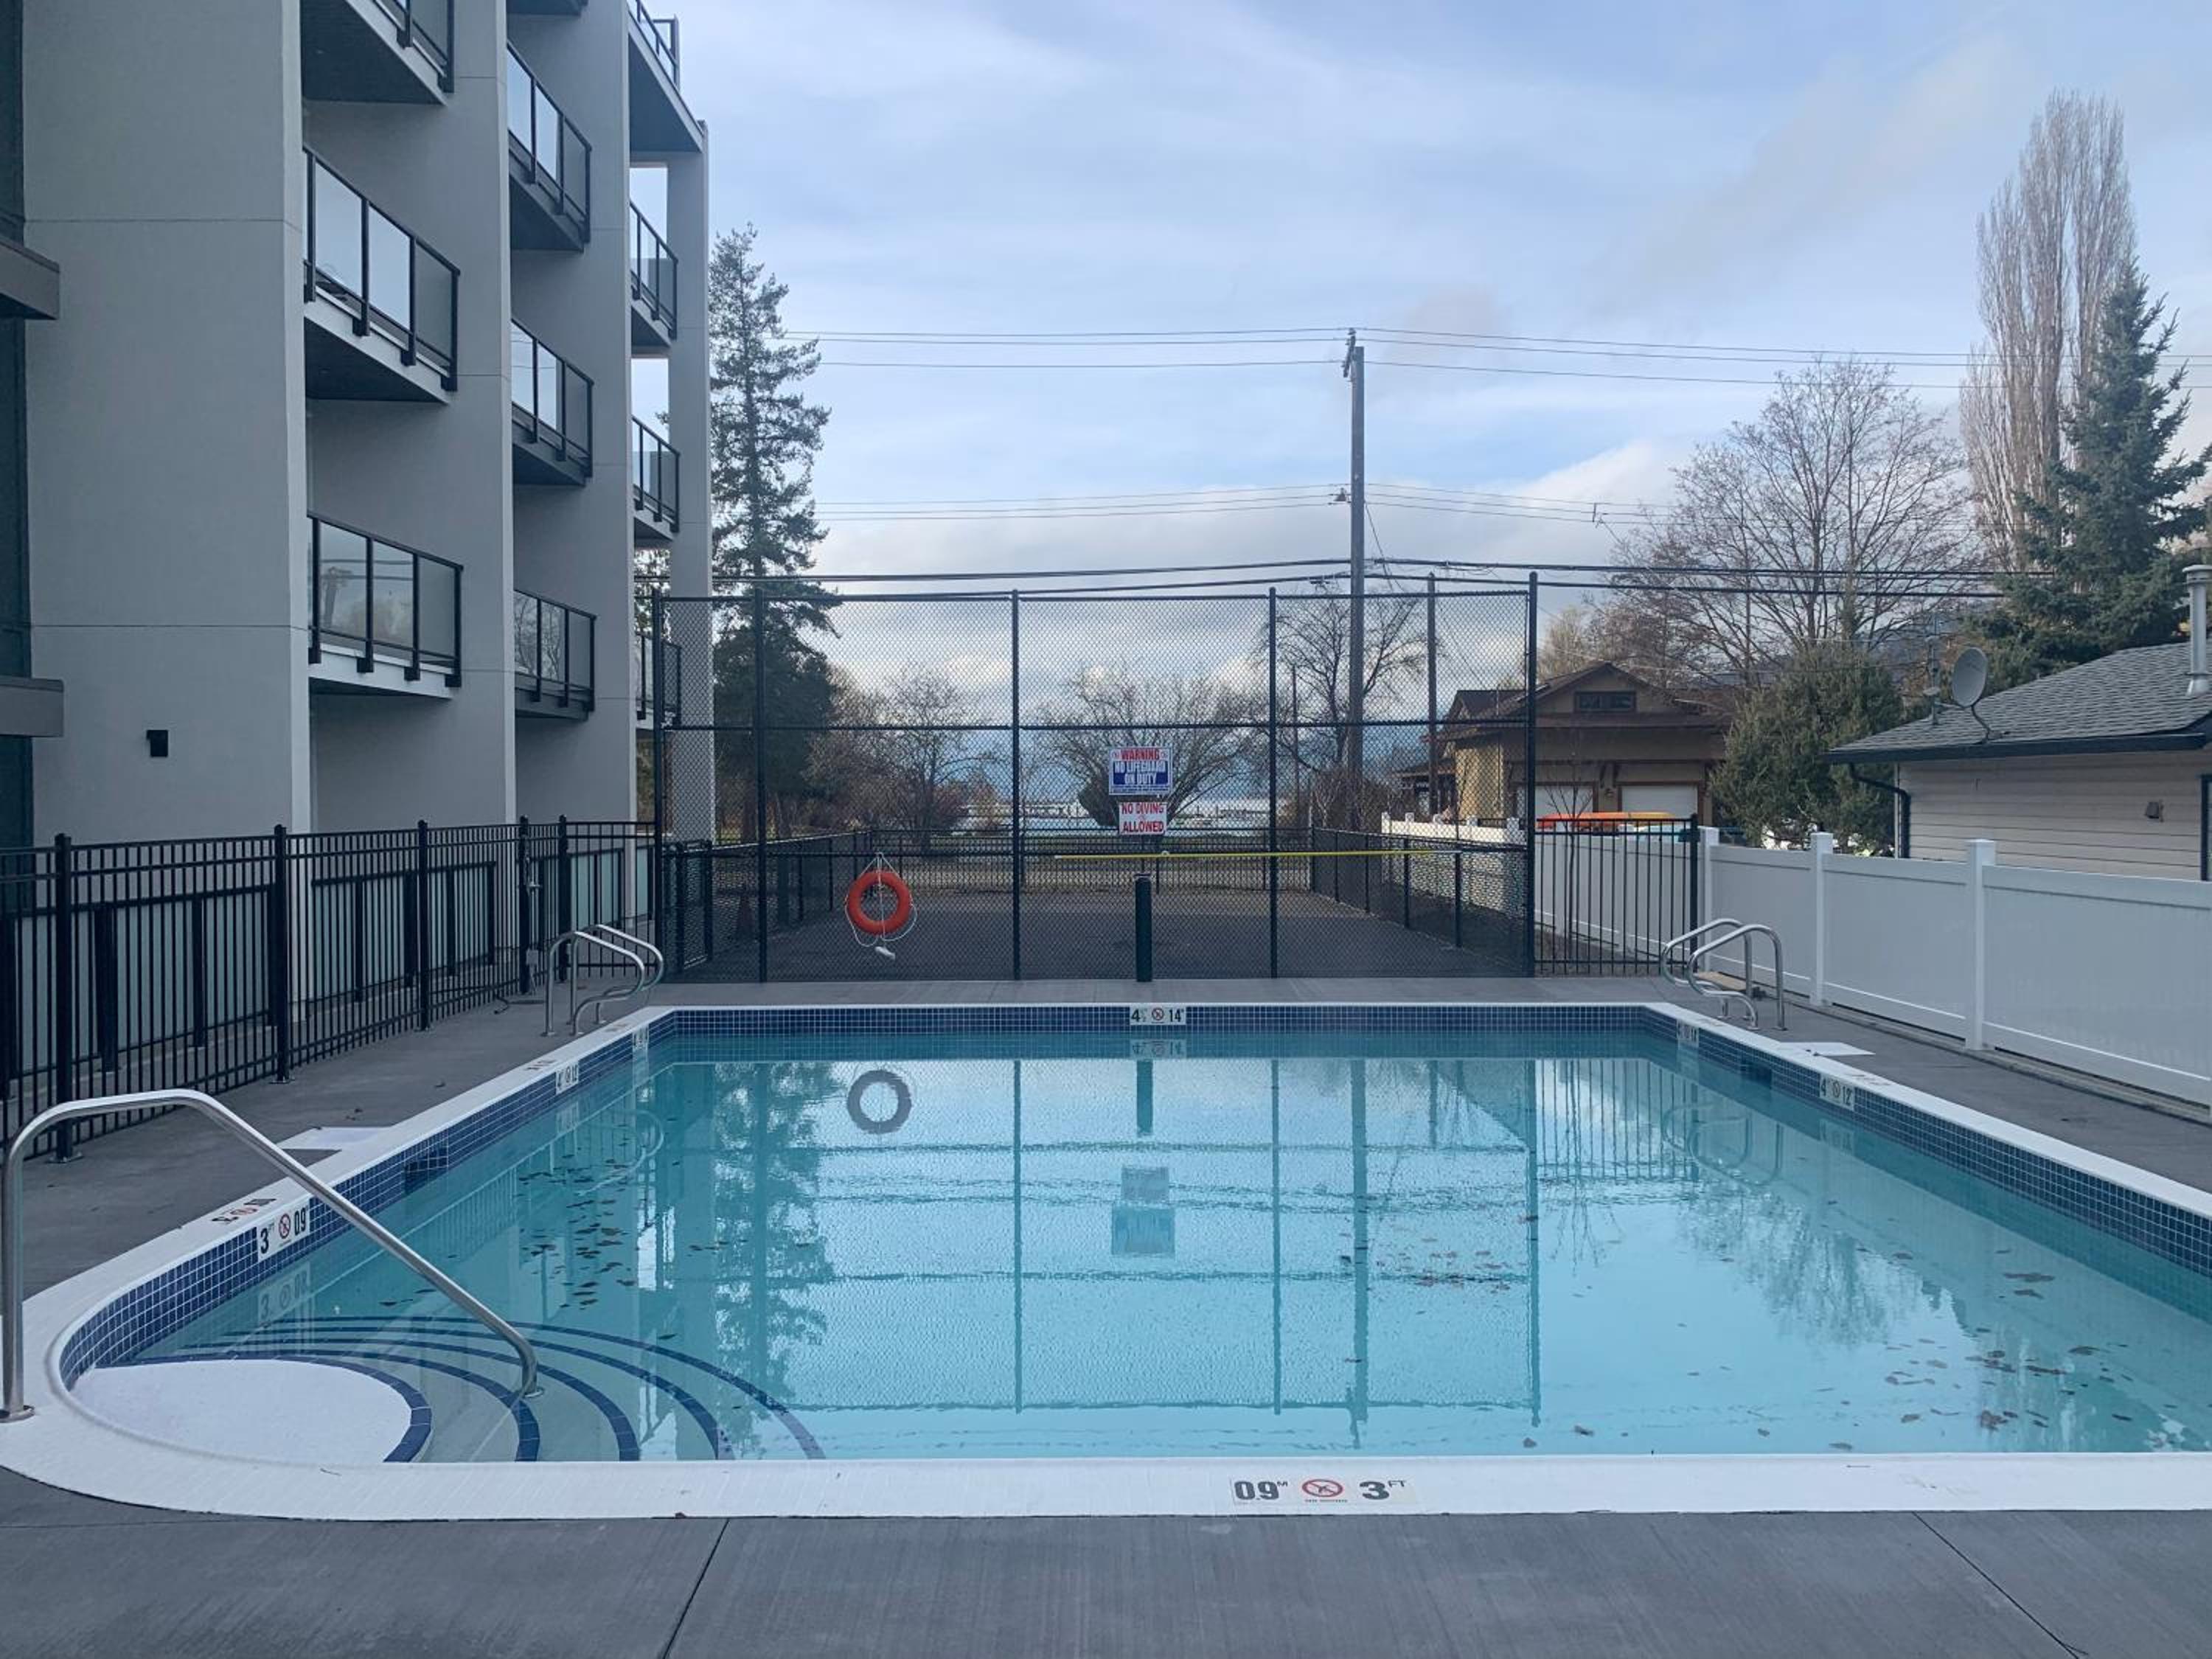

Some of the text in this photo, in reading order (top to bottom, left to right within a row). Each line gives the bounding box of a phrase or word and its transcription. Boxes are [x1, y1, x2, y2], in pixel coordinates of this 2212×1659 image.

[1121, 748, 1160, 760] WARNING
[1114, 761, 1166, 773] NO LIFEGUARD
[1124, 773, 1157, 785] ON DUTY
[1121, 802, 1164, 815] NO DIVING
[1123, 821, 1164, 832] ALLOWED
